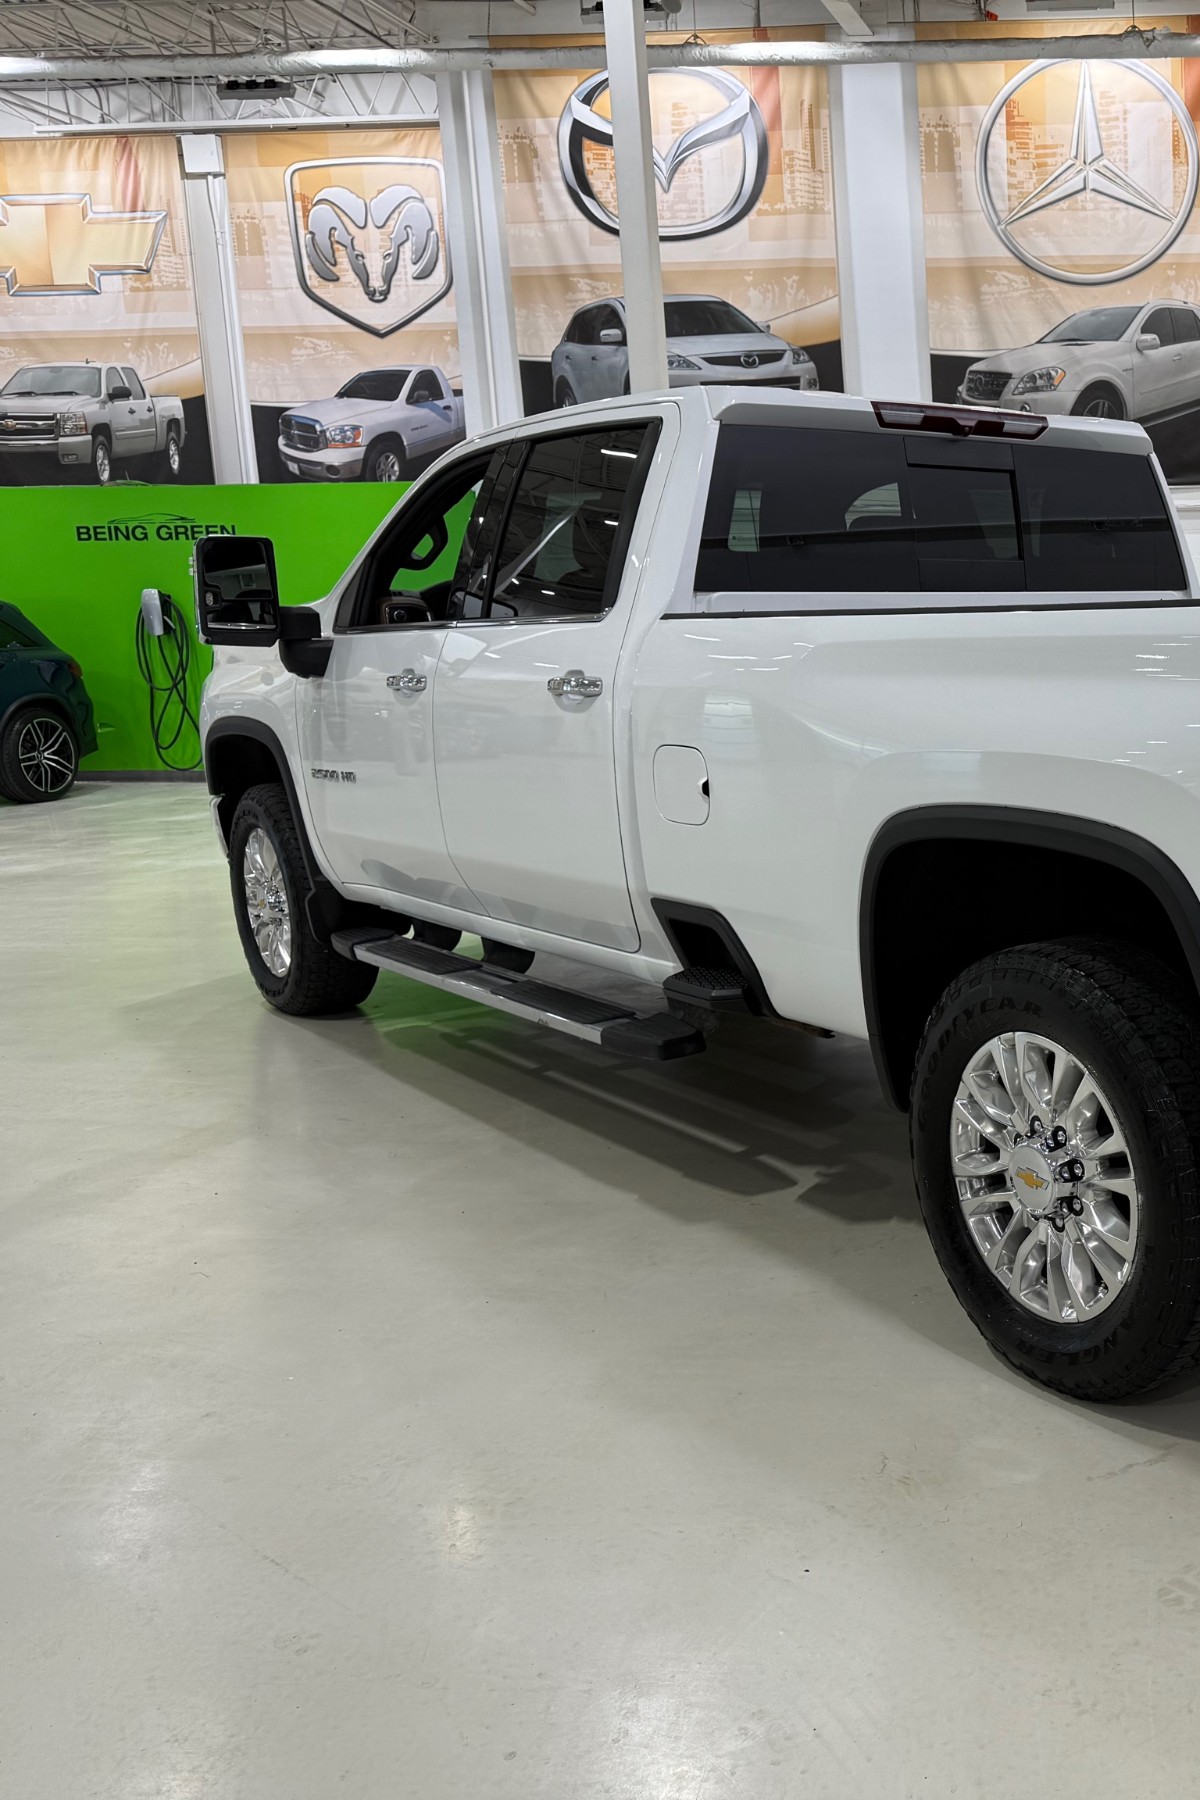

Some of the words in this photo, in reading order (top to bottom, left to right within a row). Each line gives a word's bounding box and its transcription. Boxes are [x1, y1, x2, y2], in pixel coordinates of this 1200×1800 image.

[76, 525, 149, 541] BEING
[156, 524, 236, 541] GREEN
[311, 768, 339, 782] 2500
[340, 770, 356, 783] HD
[917, 996, 1042, 1133] GOODYEAR
